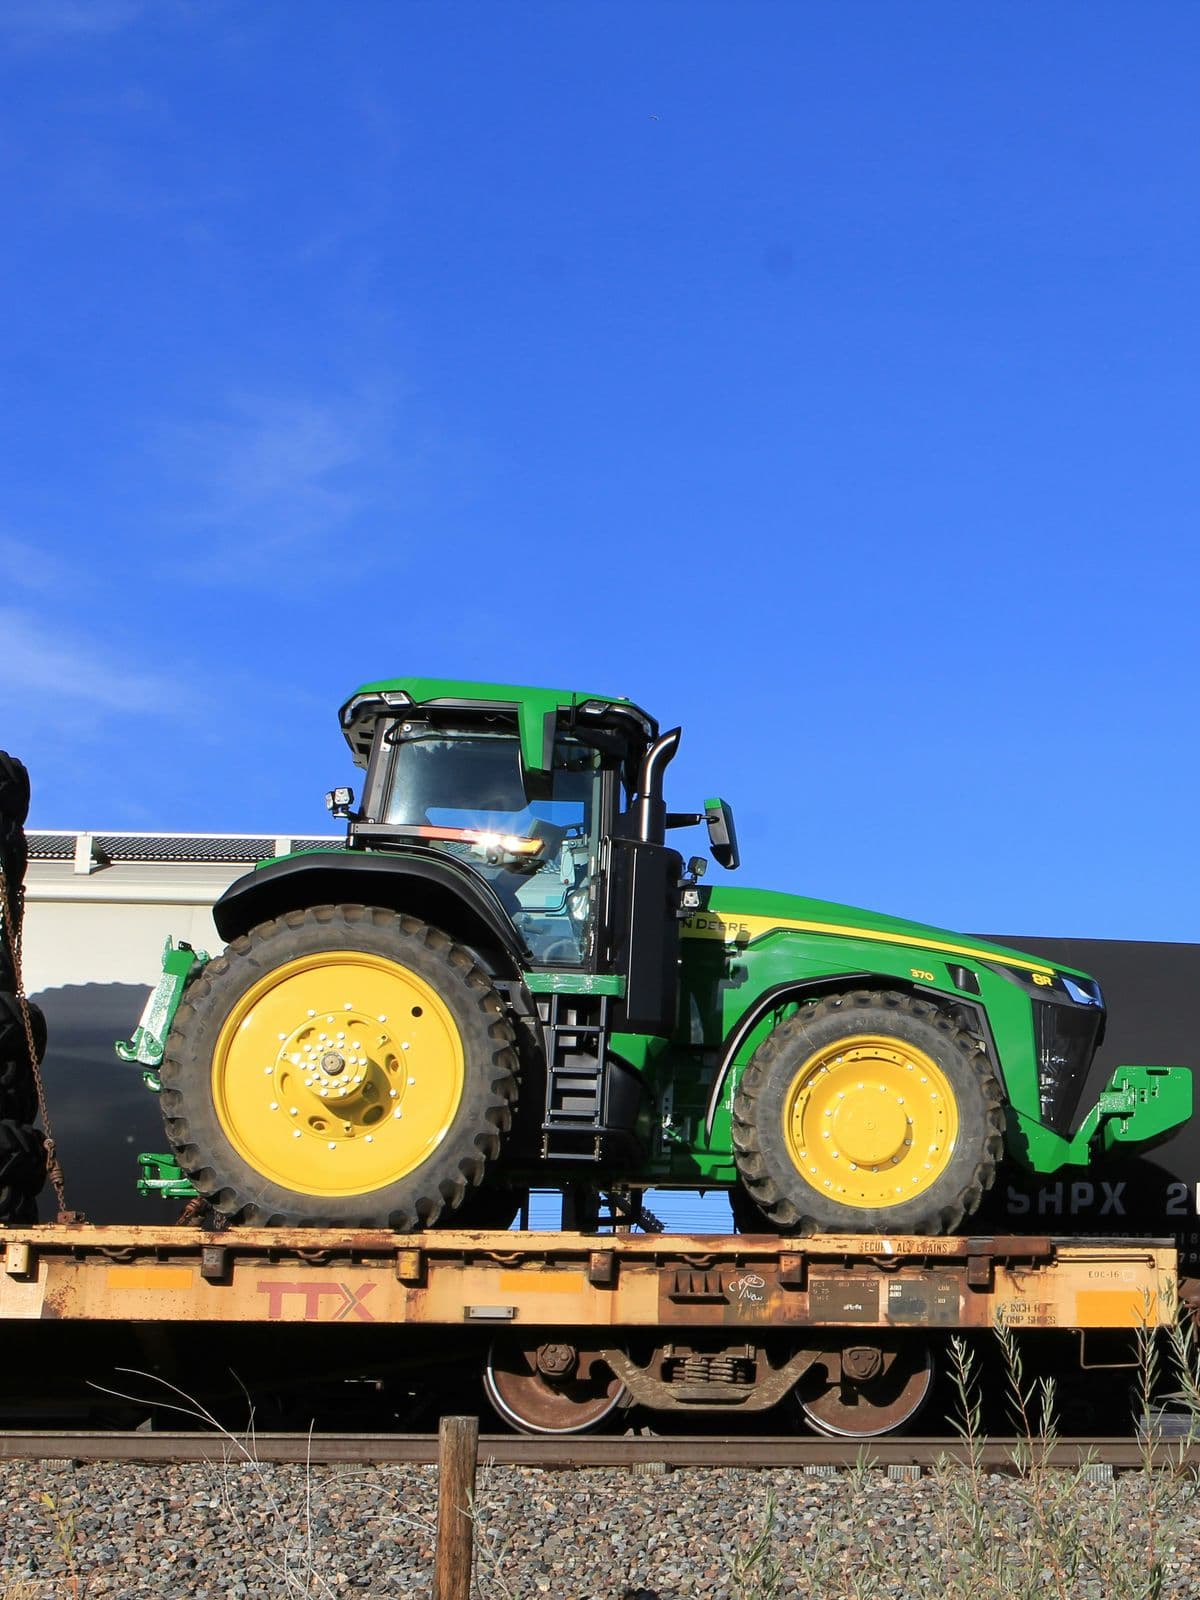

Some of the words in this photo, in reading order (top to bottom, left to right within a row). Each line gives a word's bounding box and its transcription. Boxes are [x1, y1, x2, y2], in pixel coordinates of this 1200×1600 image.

[696, 918, 748, 933] DEERE
[910, 968, 935, 981] 370
[1031, 973, 1052, 988] 8R
[1007, 1182, 1127, 1216] SHPX
[256, 1281, 377, 1321] TTX
[1010, 1303, 1031, 1313] INCH
